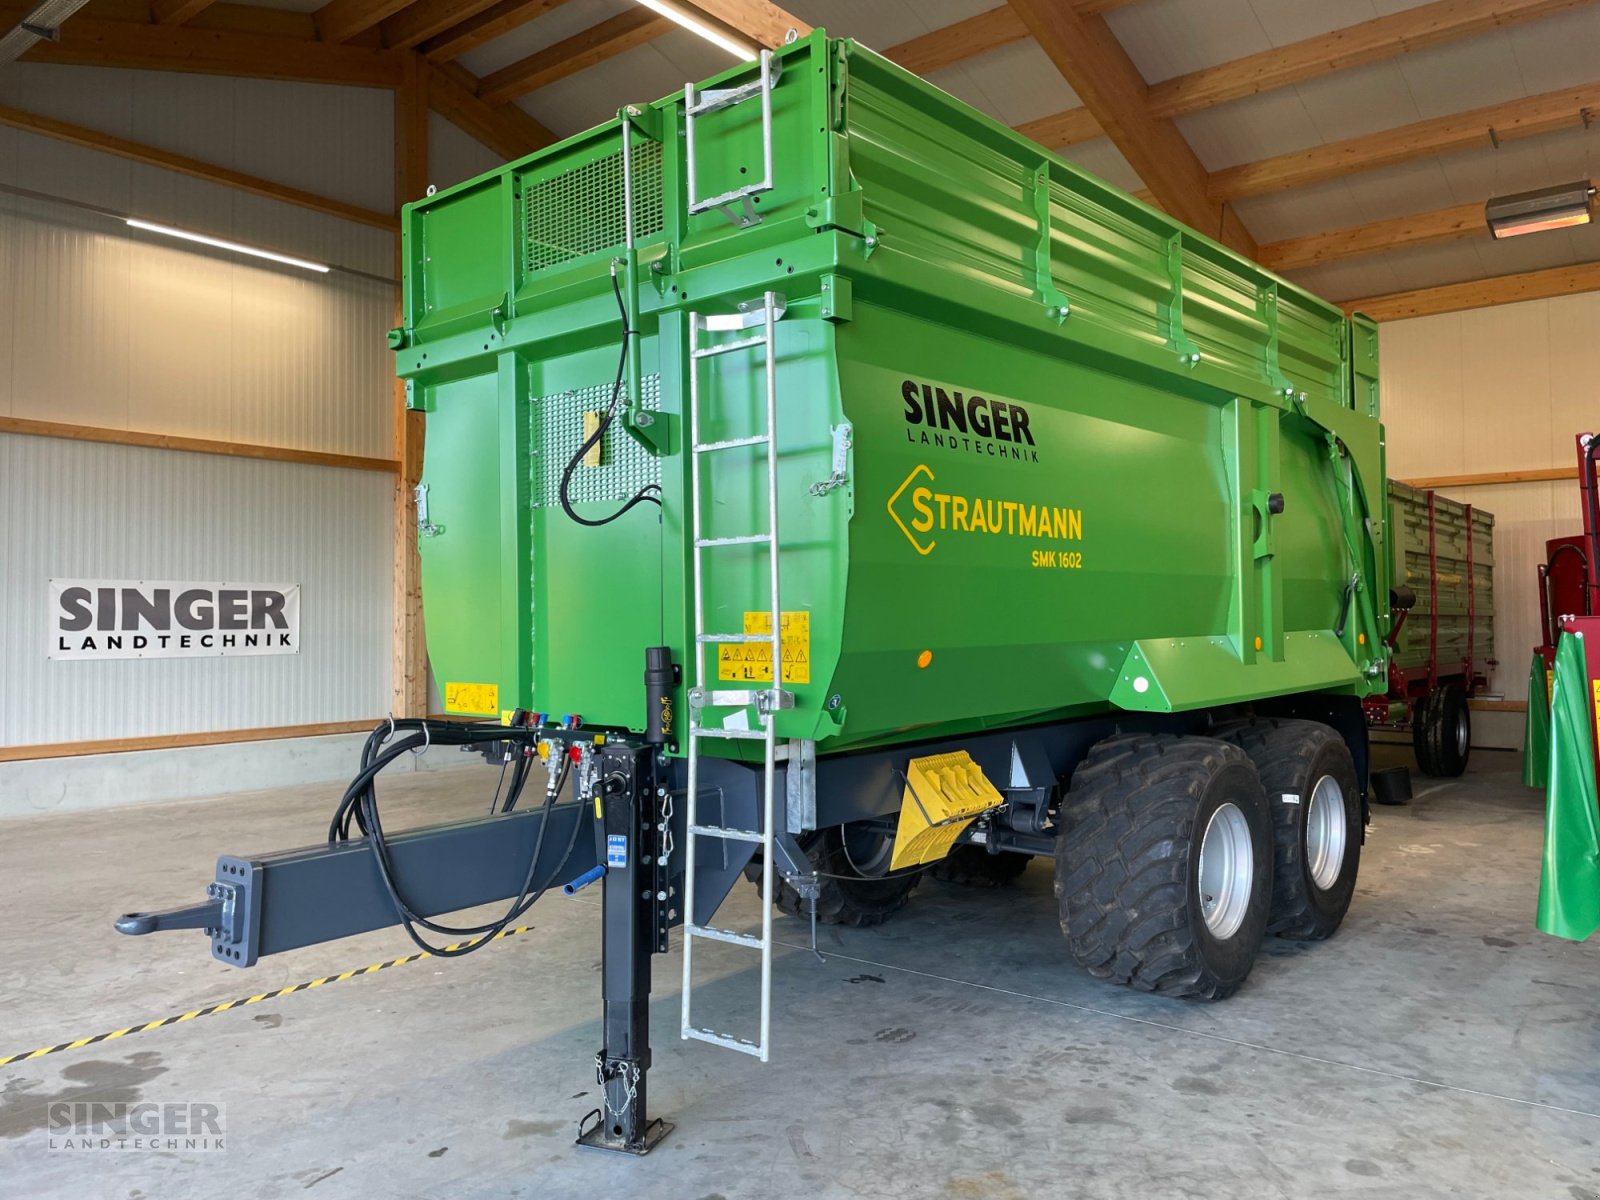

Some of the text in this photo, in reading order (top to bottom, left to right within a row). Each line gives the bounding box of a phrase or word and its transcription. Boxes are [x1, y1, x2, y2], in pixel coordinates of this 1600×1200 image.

[901, 380, 1036, 446] SINGER
[907, 428, 1039, 463] LANDTECHNIK
[911, 487, 1082, 540] STRAUTMANN
[1031, 550, 1082, 569] SMK 1602
[59, 586, 289, 632] SINGER
[59, 633, 291, 650] LANDTECHNIK
